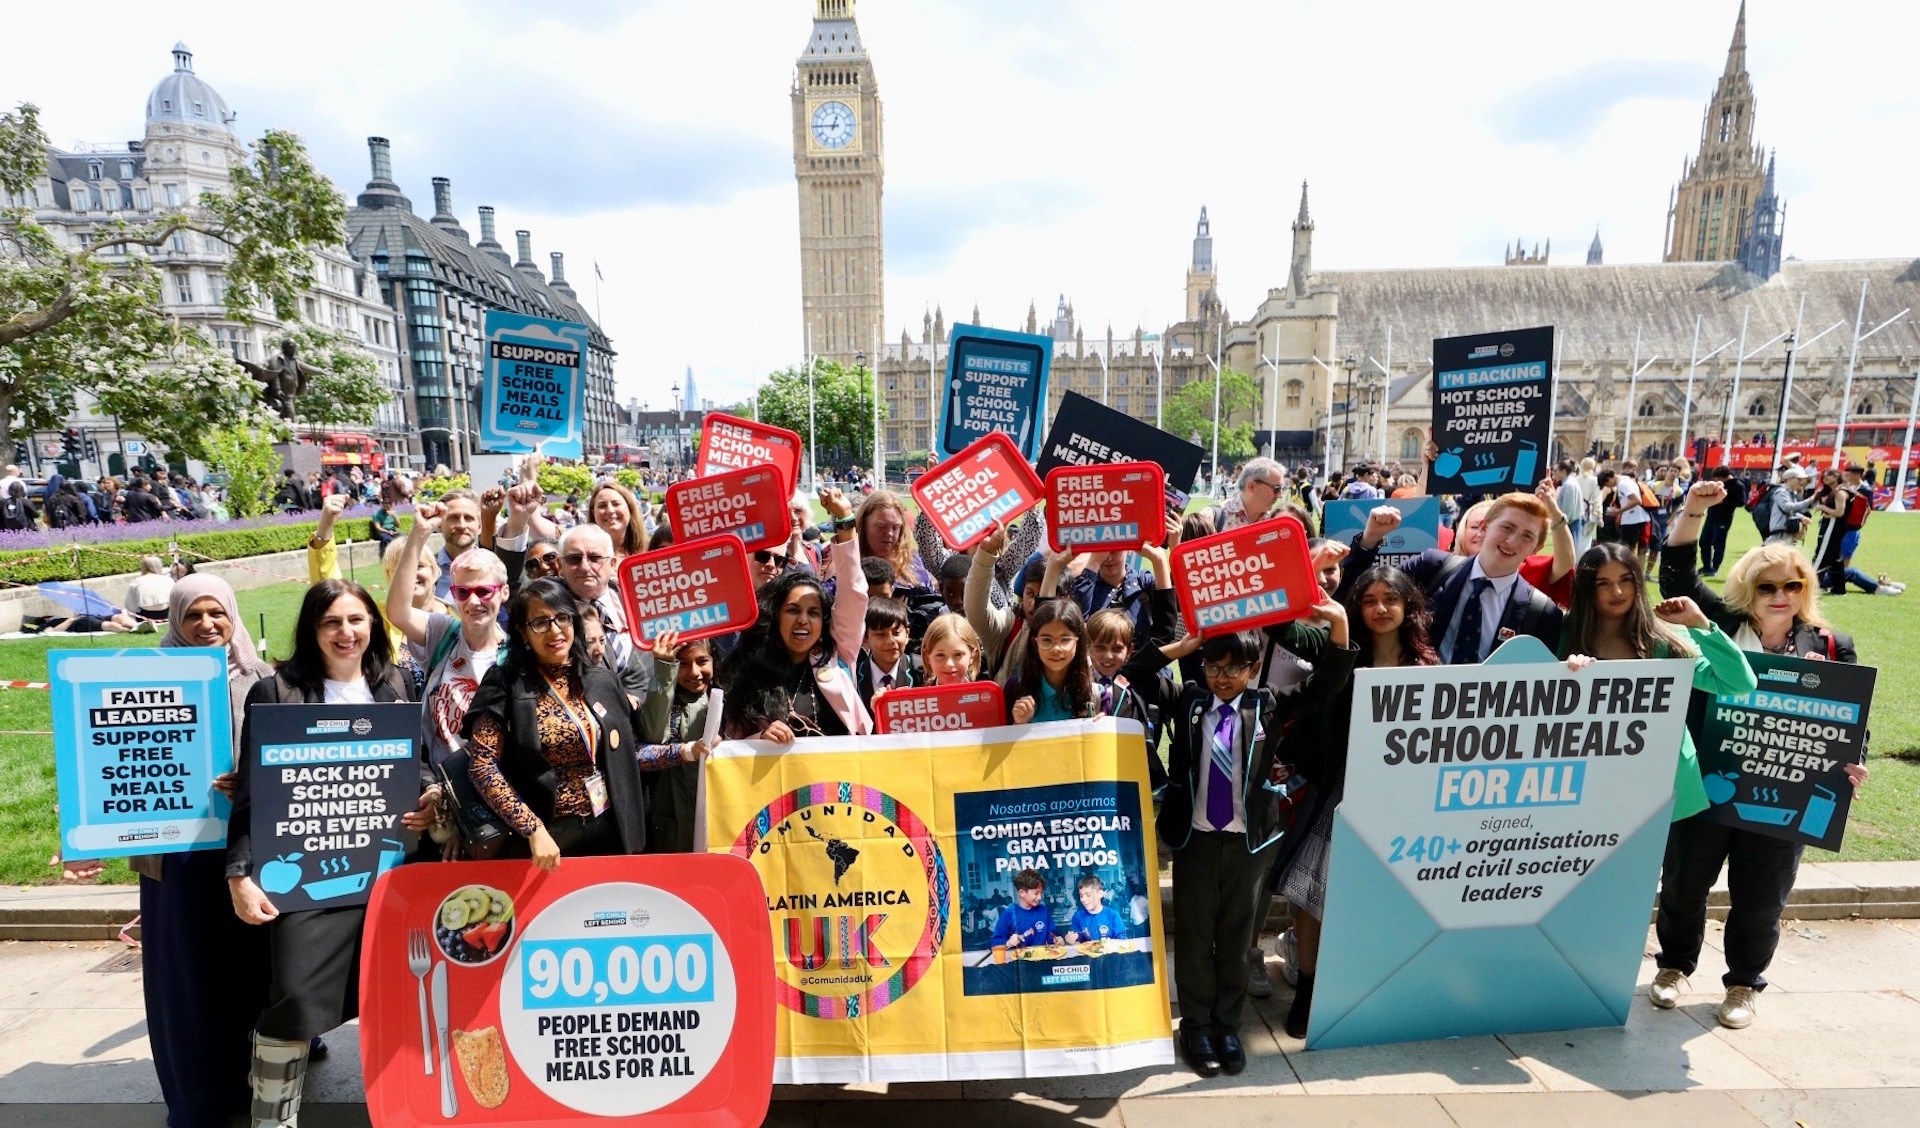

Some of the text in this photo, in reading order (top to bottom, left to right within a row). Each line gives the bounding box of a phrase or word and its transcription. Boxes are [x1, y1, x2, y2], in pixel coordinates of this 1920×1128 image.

[493, 344, 578, 366] I SUPPORT
[967, 357, 1029, 372] DENTISTS
[514, 364, 554, 379] FREE
[965, 372, 1028, 388] SUPPORT
[1442, 365, 1542, 387] I'M BACKING
[502, 376, 565, 395] SCHOOL
[978, 384, 1012, 399] FREE
[1440, 385, 1542, 404] HOT SCHOOL
[507, 390, 559, 407] MEALS
[967, 396, 1020, 412] SCHOOL
[1455, 401, 1526, 417] DINNERS
[500, 403, 563, 421] FOR ALL
[970, 408, 1015, 423] MEALS
[712, 421, 752, 442] FREE
[964, 420, 1018, 435] FOR ALL
[1446, 415, 1535, 431] FOR EVERY
[710, 436, 773, 461] SCHOOL
[1069, 433, 1111, 460] FREE
[1464, 431, 1513, 445] CHILD
[1053, 444, 1098, 466] MEA
[676, 481, 726, 505] FREE
[922, 466, 966, 501] FREE
[932, 466, 999, 513] SCHOOL
[1057, 474, 1104, 492] FREE
[679, 492, 757, 522] SCHOOL
[941, 484, 998, 526] MEALS
[1057, 489, 1134, 507] SCHOOL
[683, 510, 747, 537] MEALS
[952, 493, 1021, 544] FOR ALL
[1058, 506, 1122, 525] MEALS
[1059, 525, 1137, 544] FOR ALL
[1182, 541, 1237, 569] FREE
[631, 556, 683, 582] FREE
[1188, 553, 1275, 587] SCHOOL
[635, 568, 718, 600] SCHOOL
[1192, 574, 1265, 605] MEALS
[639, 588, 708, 617] MEALS
[1198, 592, 1287, 628] FOR ALL
[642, 606, 728, 639] FOR ALL
[111, 690, 175, 705] FAITH
[888, 697, 939, 717] FREE
[1371, 677, 1674, 723] WE DEMAND FREE
[1755, 694, 1853, 720] BACKING
[94, 707, 193, 725] LEADERS
[890, 712, 973, 733] SCHOOL
[1716, 708, 1851, 743] HOT SCHOOL
[92, 729, 196, 746] SUPPORT
[1383, 719, 1647, 766] SCHOOL MEALS
[1733, 727, 1826, 755] DINNERS
[119, 747, 173, 762] FREE
[265, 743, 409, 763] COUNCILLORS
[1720, 739, 1838, 773] FOR EVERY
[101, 763, 191, 780] SCHOOL
[281, 764, 394, 783] BACK HOT
[1741, 760, 1806, 783] CHILD
[110, 780, 184, 797] MEALS
[292, 782, 382, 800] SCHOOL
[1440, 765, 1577, 807] FOR ALL
[103, 796, 193, 814] FOR ALL
[288, 799, 386, 818] DINNERS
[989, 797, 1115, 816] Nosotros apoyamos
[276, 815, 397, 837] FOR EVERY
[760, 805, 915, 858] OMUNIDAD
[970, 815, 1131, 841] COMIDA ESCOLAR
[1480, 815, 1534, 832] signed,
[303, 834, 371, 852] CHILD
[1006, 833, 1106, 855] GRATUITA
[1387, 830, 1619, 865] 240+ organisations
[995, 850, 1118, 872] PARA TODOS
[1417, 856, 1595, 881] and civil society
[823, 889, 911, 908] AMERICA
[1461, 884, 1543, 903] leaders
[600, 918, 626, 926] BEHIND
[783, 913, 891, 970] UK
[528, 943, 707, 1004] 90,000
[800, 975, 873, 985] @ComunidadUK
[1060, 974, 1089, 982] BEHIND
[538, 1010, 700, 1036] PEOPLE DEMAND
[554, 1034, 686, 1059] FREE SCHOOL
[546, 1056, 695, 1082] MEALS FOR ALL
